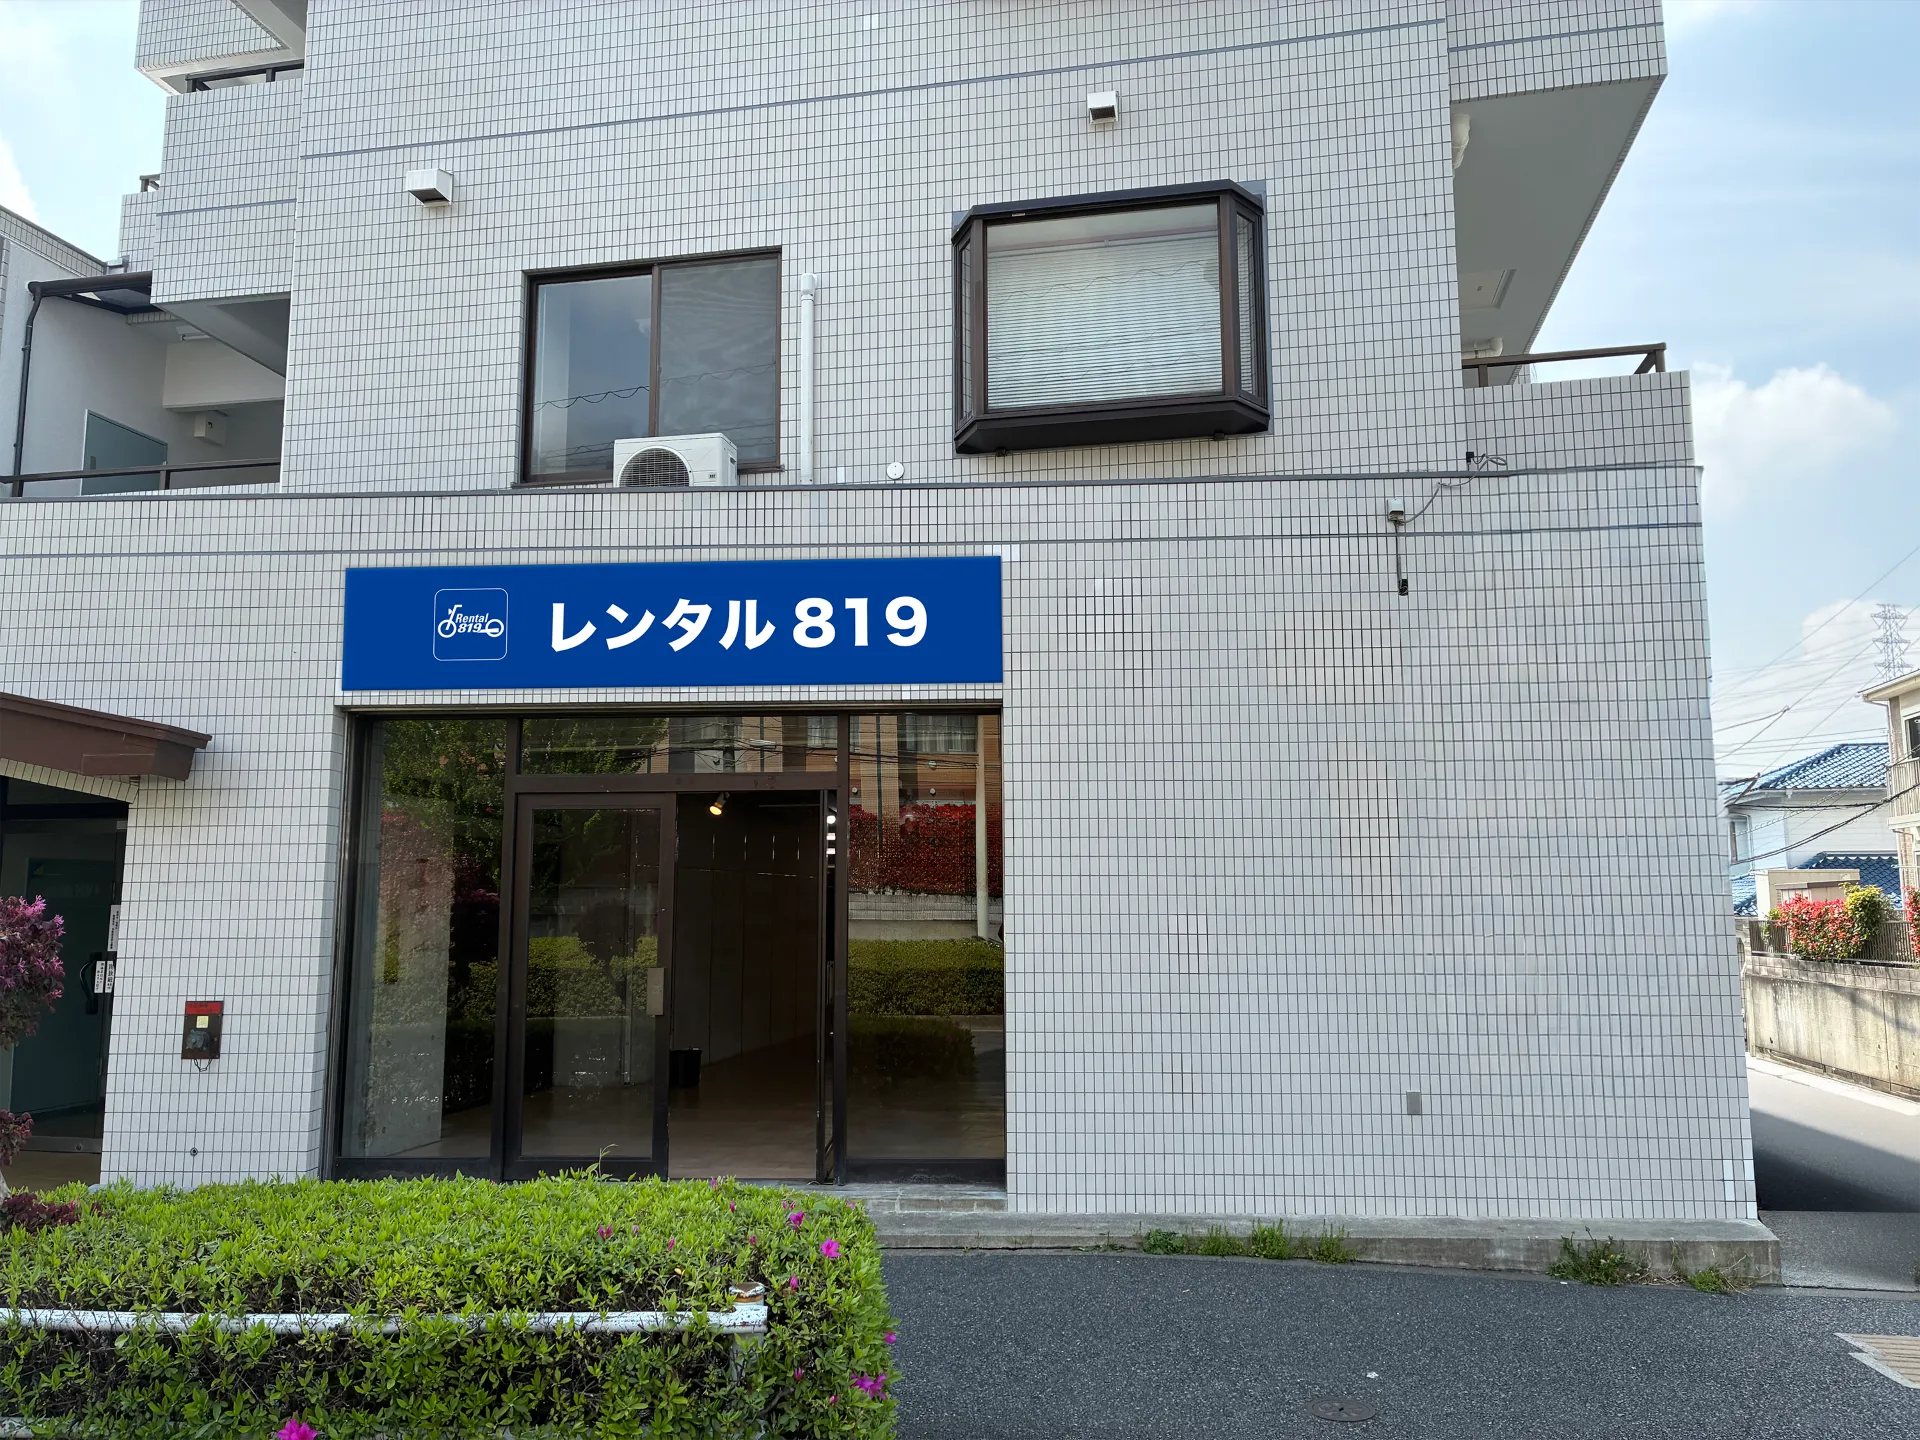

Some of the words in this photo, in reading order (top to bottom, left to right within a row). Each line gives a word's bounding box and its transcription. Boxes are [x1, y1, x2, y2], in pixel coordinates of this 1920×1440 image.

[456, 613, 489, 623] Rental
[457, 623, 482, 633] 819
[551, 599, 776, 652] レンタル
[793, 596, 928, 649] 819
